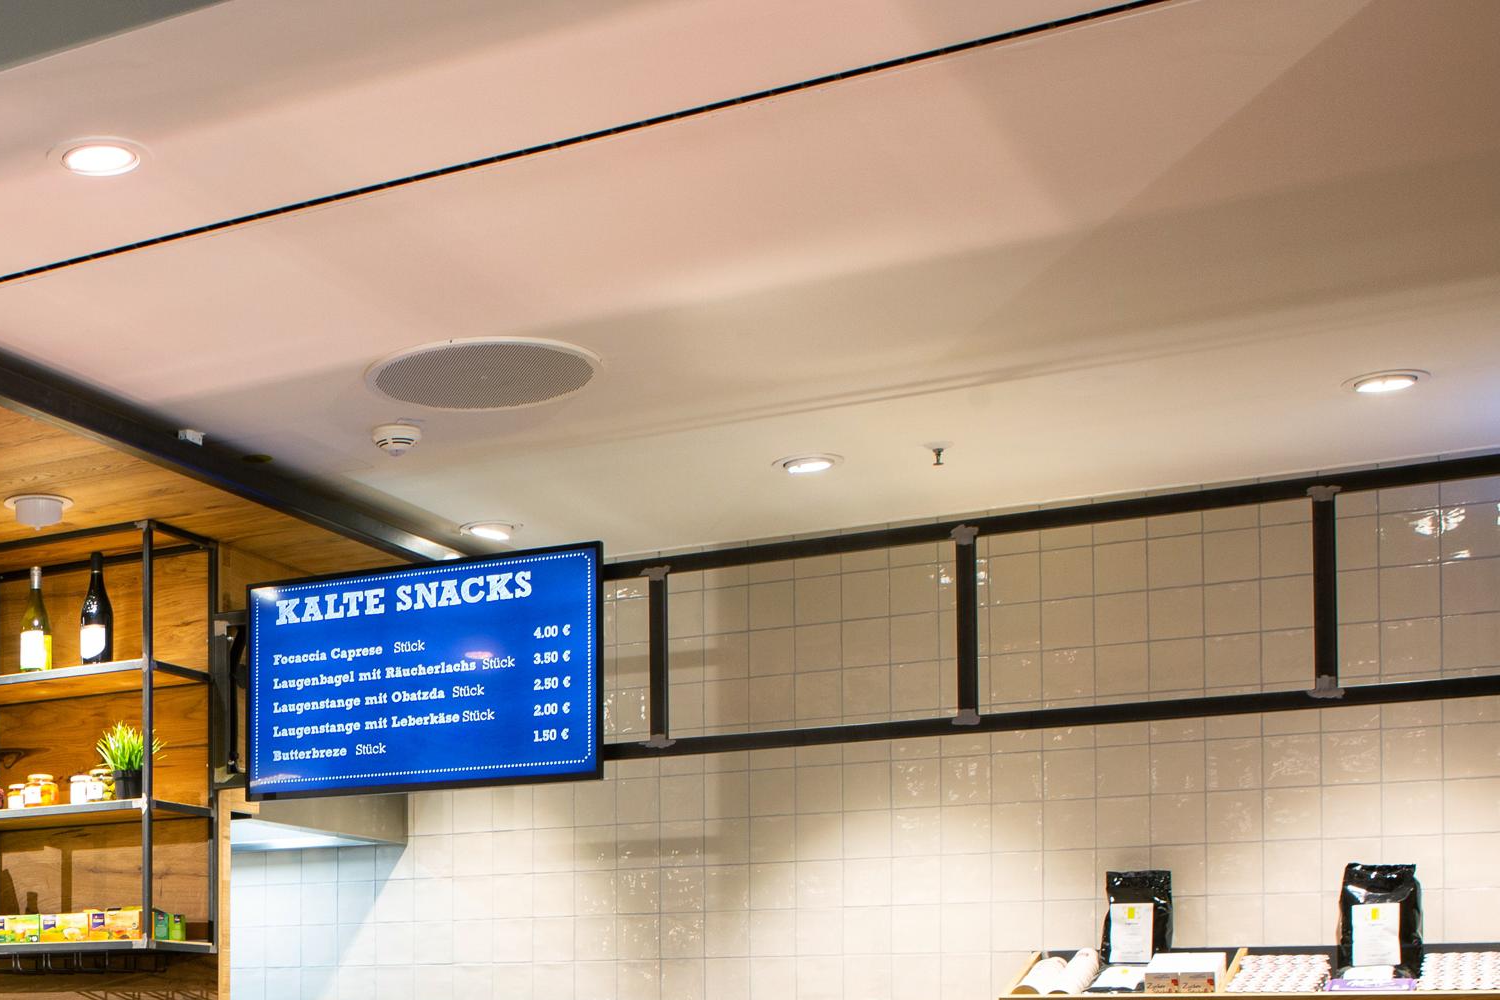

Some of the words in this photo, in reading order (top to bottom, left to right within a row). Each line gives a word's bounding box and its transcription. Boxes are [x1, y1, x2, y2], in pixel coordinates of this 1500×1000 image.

[276, 588, 385, 625] KALTE
[397, 571, 532, 611] SNACKS
[534, 626, 558, 639] 4.00
[562, 625, 570, 636] €
[273, 651, 327, 666] Focaccia
[331, 645, 382, 662] Caprese
[394, 639, 425, 654] Stück
[534, 652, 558, 664] 3.50
[562, 650, 570, 662] €
[273, 672, 354, 691] Laugenbagel
[359, 667, 381, 682] mit
[386, 659, 476, 679] Räucherlachs
[482, 655, 515, 670] Stück
[534, 678, 558, 691] 2.50
[562, 676, 570, 688] €
[273, 696, 360, 716] Laugenstange
[365, 692, 387, 706] mit
[391, 687, 445, 703] Obatzda
[452, 684, 484, 699] Stück
[534, 704, 558, 716] 2.00
[562, 702, 570, 714] €
[273, 720, 360, 739] Laugenstange
[365, 716, 387, 730] mit
[391, 711, 459, 728] Leberkäse
[462, 708, 494, 723] Stück
[534, 729, 557, 742] 1.50
[561, 728, 569, 740] €
[273, 745, 347, 762] Butterbreze
[355, 741, 386, 756] Stück
